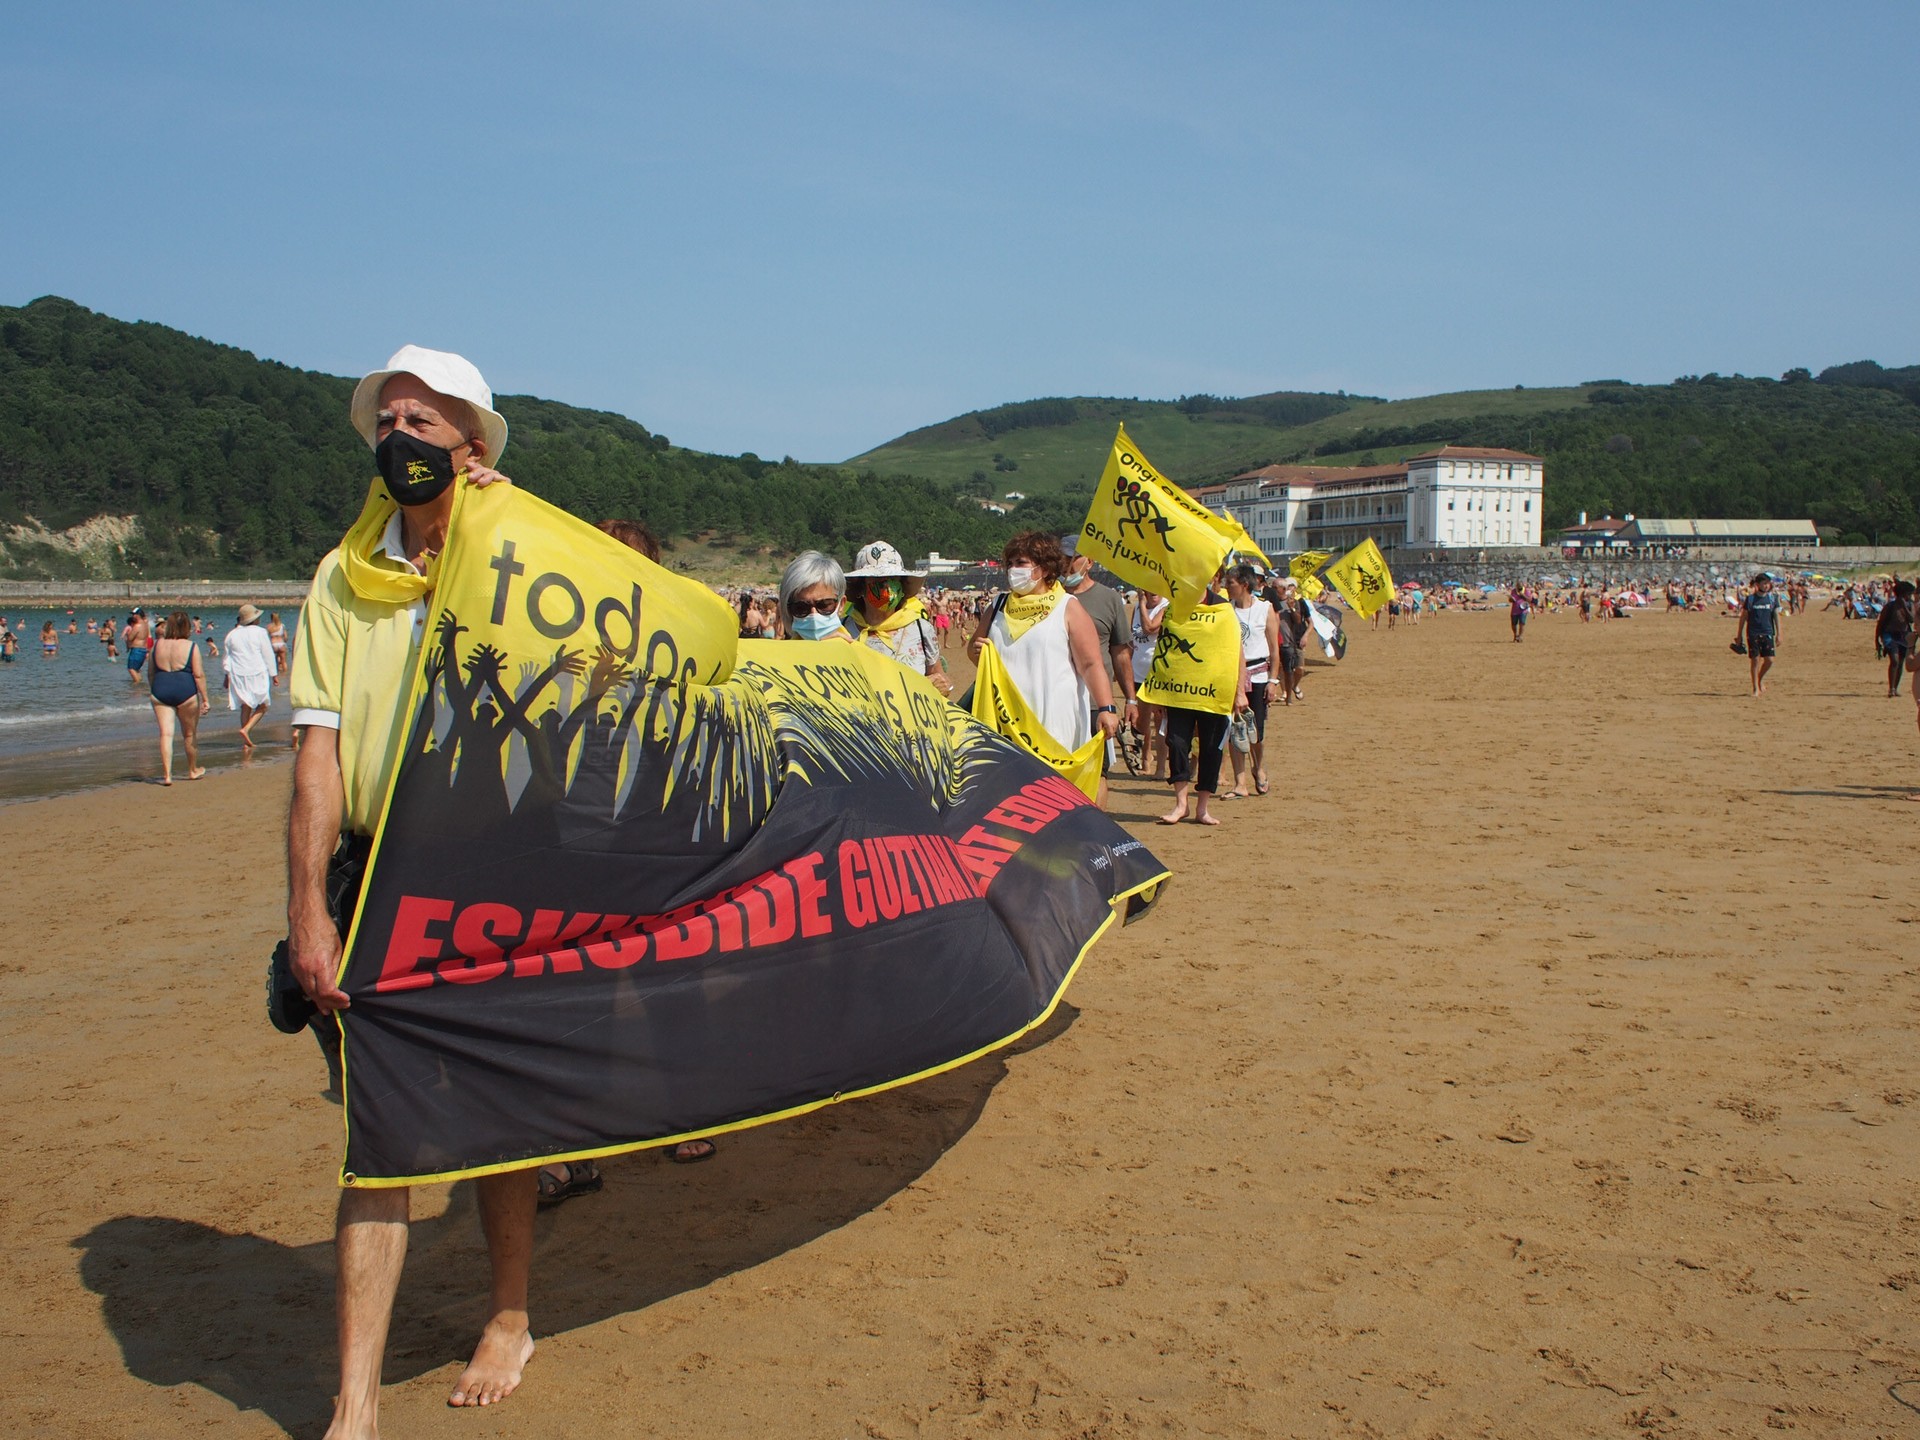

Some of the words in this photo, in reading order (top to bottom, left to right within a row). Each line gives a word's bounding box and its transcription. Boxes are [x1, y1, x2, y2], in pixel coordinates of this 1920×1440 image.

[1120, 452, 1158, 483] Ongi
[1582, 546, 1665, 560] AMNISTIA
[1189, 611, 1216, 624] orri
[375, 851, 834, 993] ESKUBIDE
